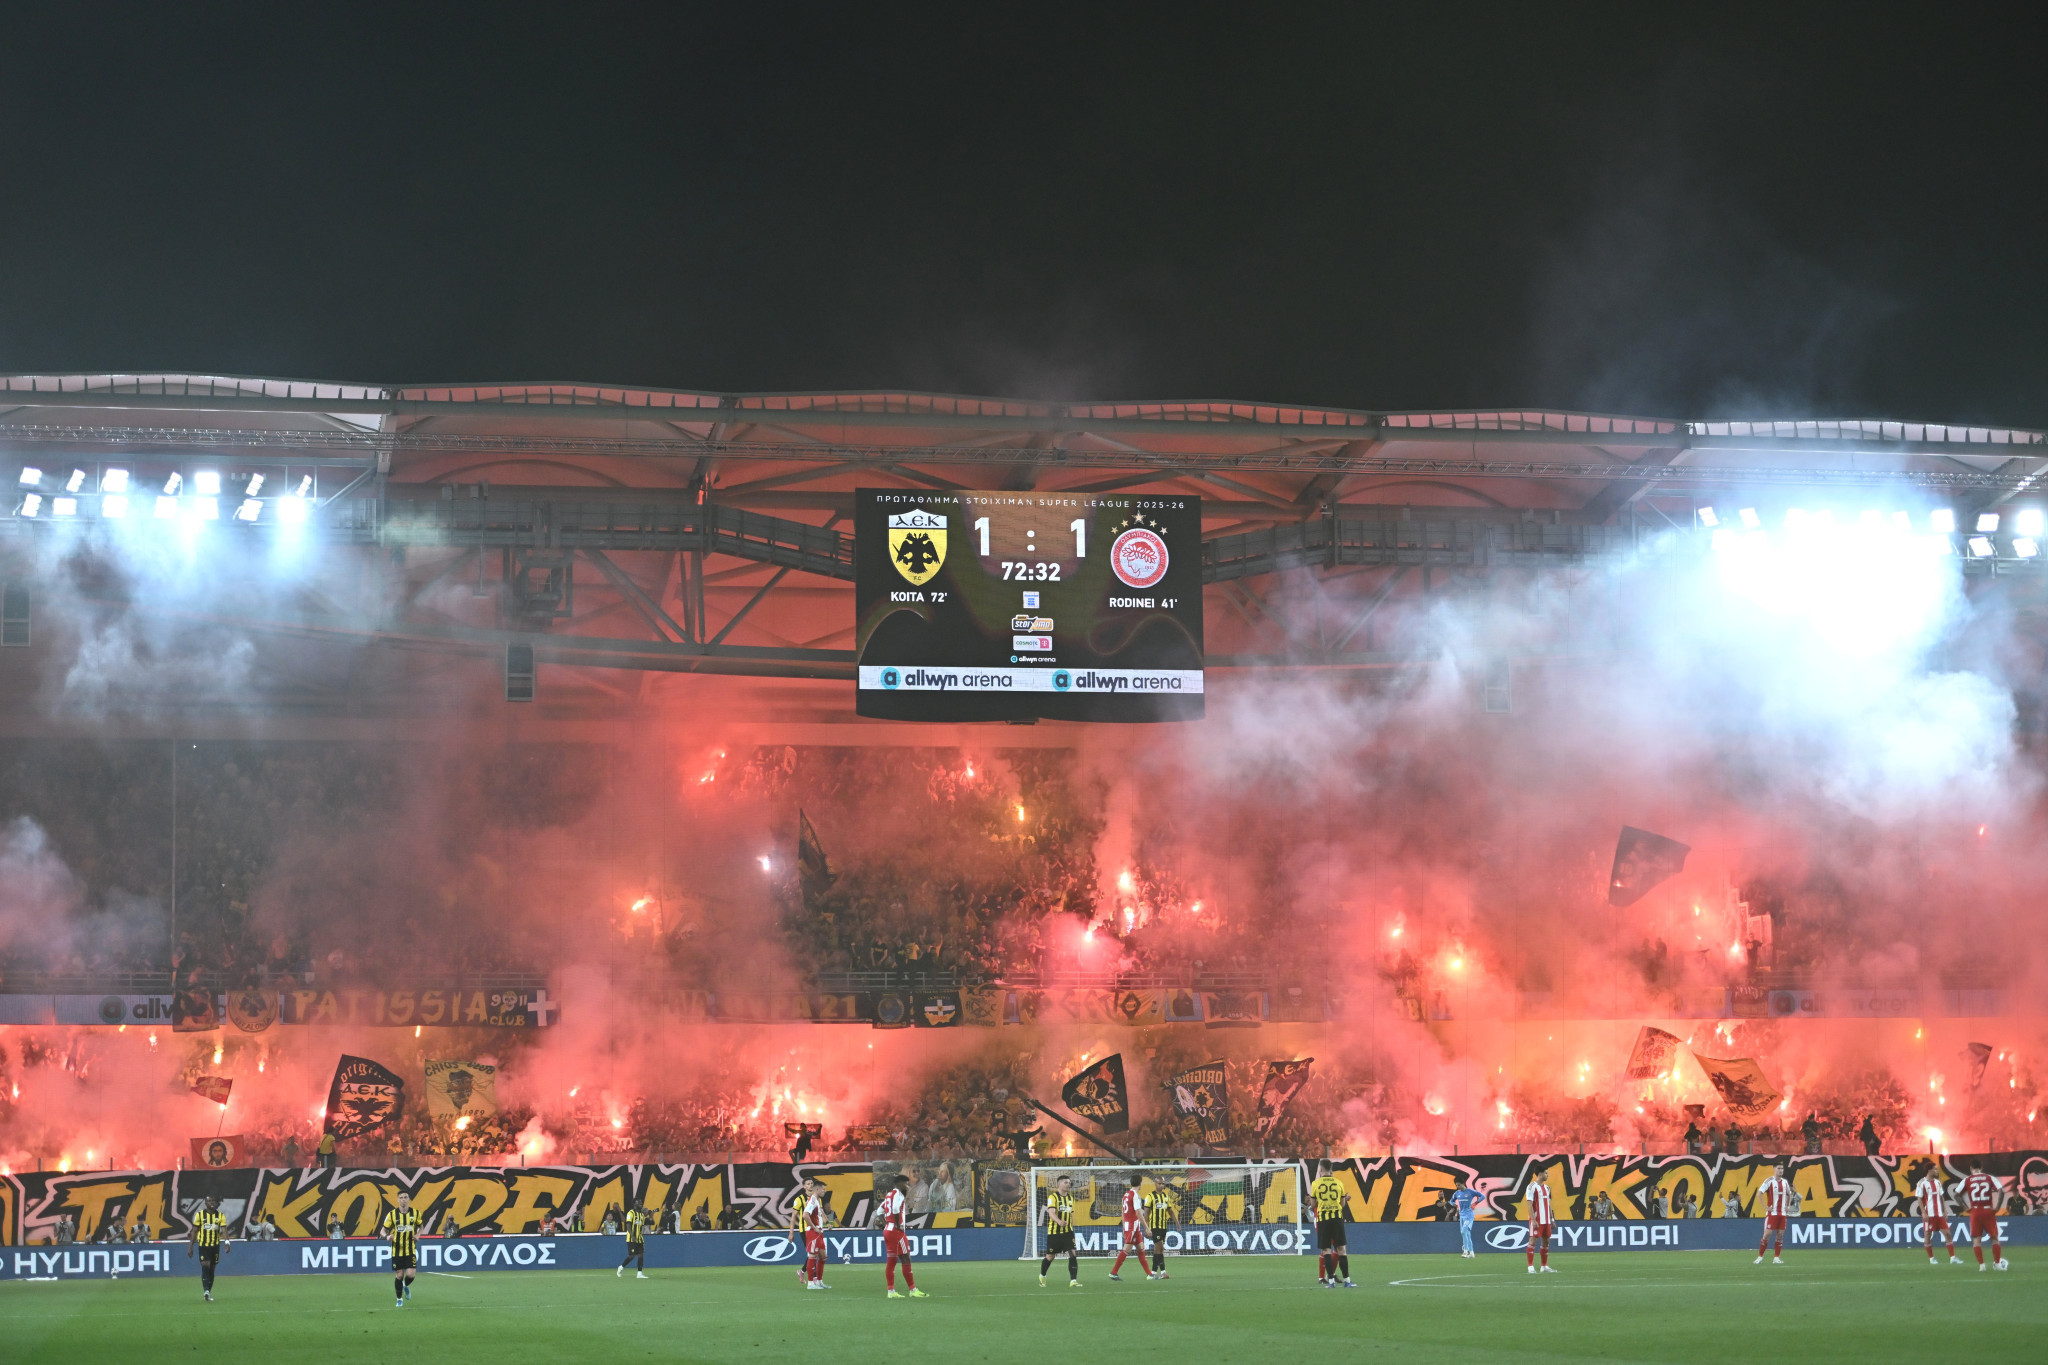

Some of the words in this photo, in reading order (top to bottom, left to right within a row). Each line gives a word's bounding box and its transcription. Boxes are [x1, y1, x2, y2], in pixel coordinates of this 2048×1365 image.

[876, 495, 959, 504] ΠΡΩΤΑΘΛΗΜΑ
[966, 497, 1033, 505] STOIXIMAN
[1039, 499, 1077, 507] SUPER
[1084, 500, 1130, 508] LEAGUE
[1136, 501, 1184, 509] 2025-26
[974, 517, 990, 556] 1
[1070, 518, 1086, 558] 1
[1001, 562, 1061, 582] 72:32
[890, 592, 925, 602] KOITA
[930, 592, 948, 603] 72'
[1109, 597, 1155, 608] RODINEI
[1161, 598, 1178, 609] 41'
[905, 669, 958, 690] allwyn
[962, 674, 1012, 687] arena
[1076, 671, 1128, 693] allwyn
[1132, 676, 1182, 690] arena
[292, 990, 488, 1024] PATISSIA
[821, 994, 856, 1017] 21
[489, 1015, 526, 1027] CLUB
[425, 1061, 459, 1077] CHIOS
[1318, 1182, 1339, 1202] 25
[1510, 1160, 1842, 1221] ΑΚΟΜΑ
[1970, 1182, 1990, 1202] 22
[60, 1180, 173, 1241] ΤΑ
[1075, 1228, 1312, 1251] ΜΗΟΠΟΥΛΟΣ
[1550, 1225, 1679, 1247] HYUNDAI
[1791, 1221, 2009, 1244] ΜΗΤΡΟΠΟΛΣ
[301, 1242, 556, 1269] ΜΗΤΡΠΟΥΛΟΣ
[824, 1234, 953, 1258] YUDAI
[14, 1249, 170, 1275] HYUNDAI
